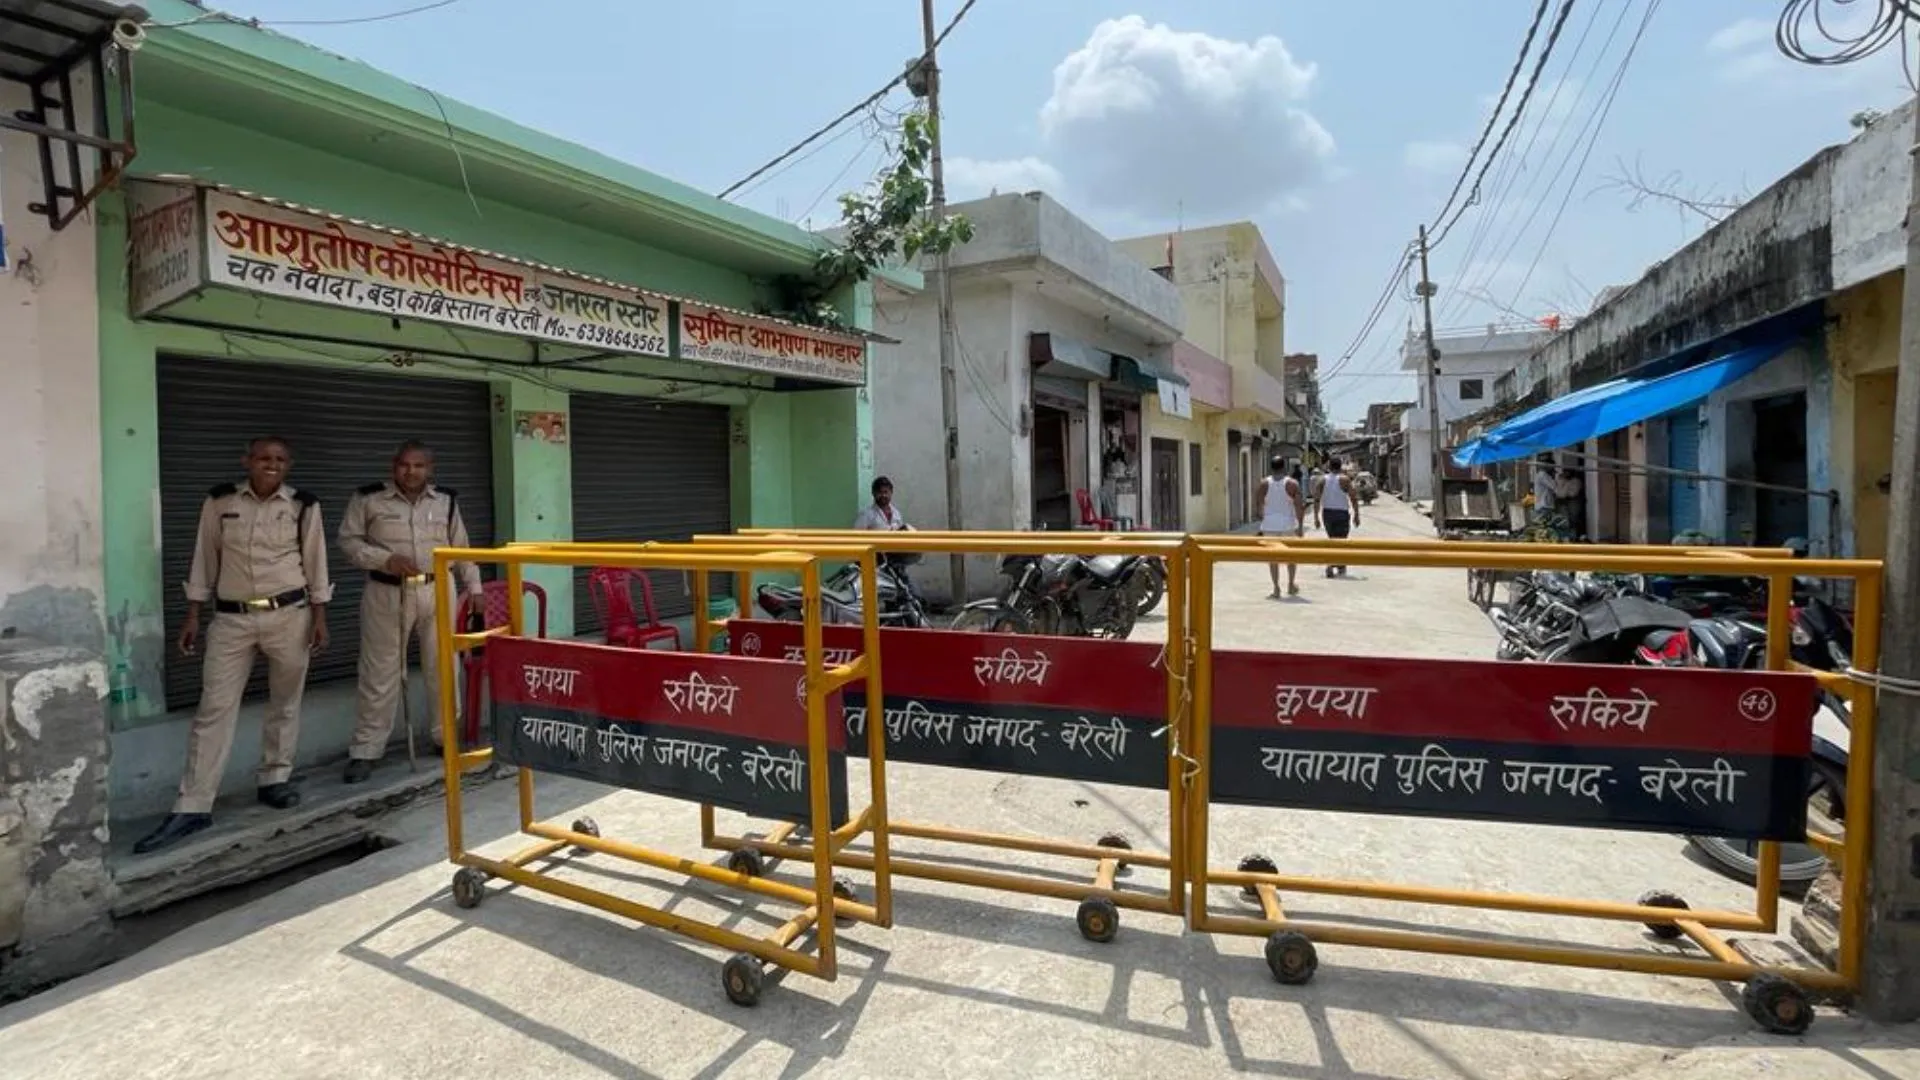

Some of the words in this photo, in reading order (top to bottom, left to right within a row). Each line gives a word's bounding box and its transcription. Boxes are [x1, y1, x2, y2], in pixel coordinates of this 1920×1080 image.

[214, 210, 373, 275] आशुतोष
[543, 284, 613, 322] जनरल
[616, 295, 661, 333] स्टोर
[227, 255, 278, 283] चक
[407, 289, 496, 322] कब्रिस्तान
[495, 306, 543, 332] बरेली
[682, 312, 745, 345] सुमित
[747, 326, 808, 357] आभूषण
[811, 338, 864, 366] भण्डार
[522, 665, 581, 698] कृपया
[662, 671, 740, 716] रुकिये
[973, 648, 1053, 686] रुकिये
[885, 700, 960, 745] पुलिस
[1059, 716, 1132, 760] बरेली
[1275, 684, 1379, 724] कृपया
[1549, 687, 1658, 732] रुकिये
[521, 717, 588, 757] यातायात
[596, 724, 648, 765] पुलिस
[741, 745, 807, 792] बरेली
[1260, 747, 1386, 791] यातायात
[1393, 743, 1489, 794] पुलिस
[1639, 757, 1748, 805] बरेली
